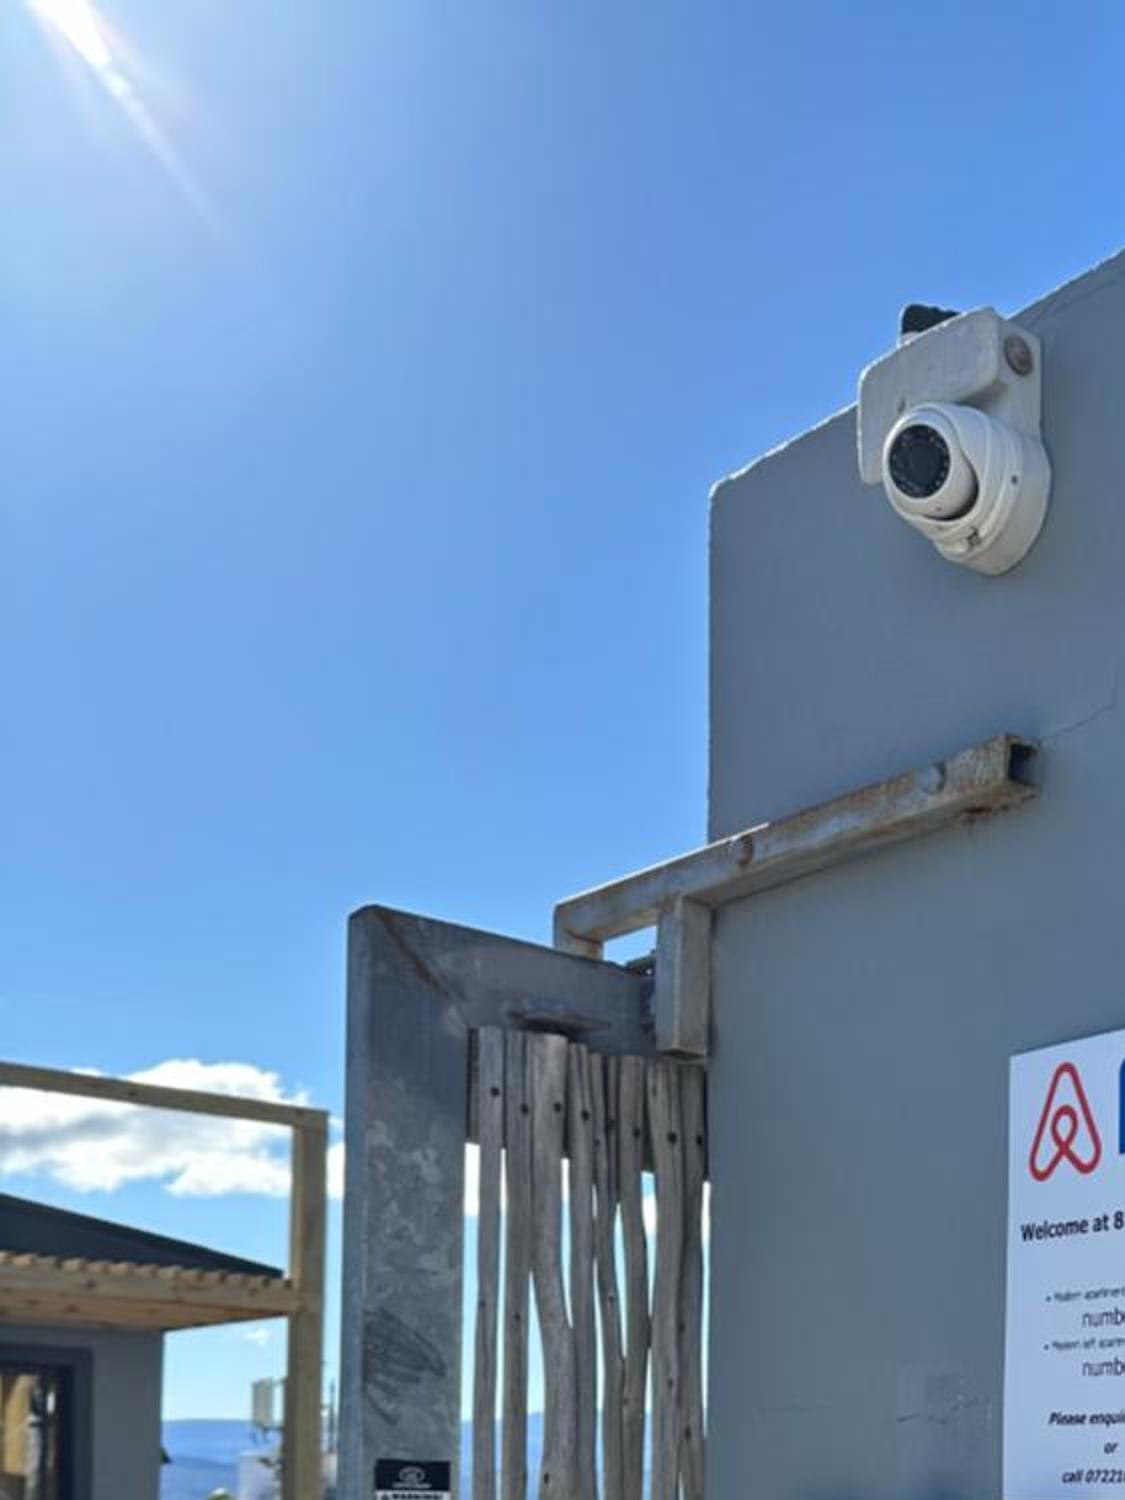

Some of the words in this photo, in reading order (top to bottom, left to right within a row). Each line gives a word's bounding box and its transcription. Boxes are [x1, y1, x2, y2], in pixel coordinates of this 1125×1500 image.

[1020, 1219, 1089, 1242] Welcome
[1092, 1213, 1109, 1232] at
[1113, 1211, 1125, 1230] 8
[1048, 1411, 1087, 1426] Please
[1103, 1441, 1119, 1455] or
[1061, 1469, 1083, 1484] call
